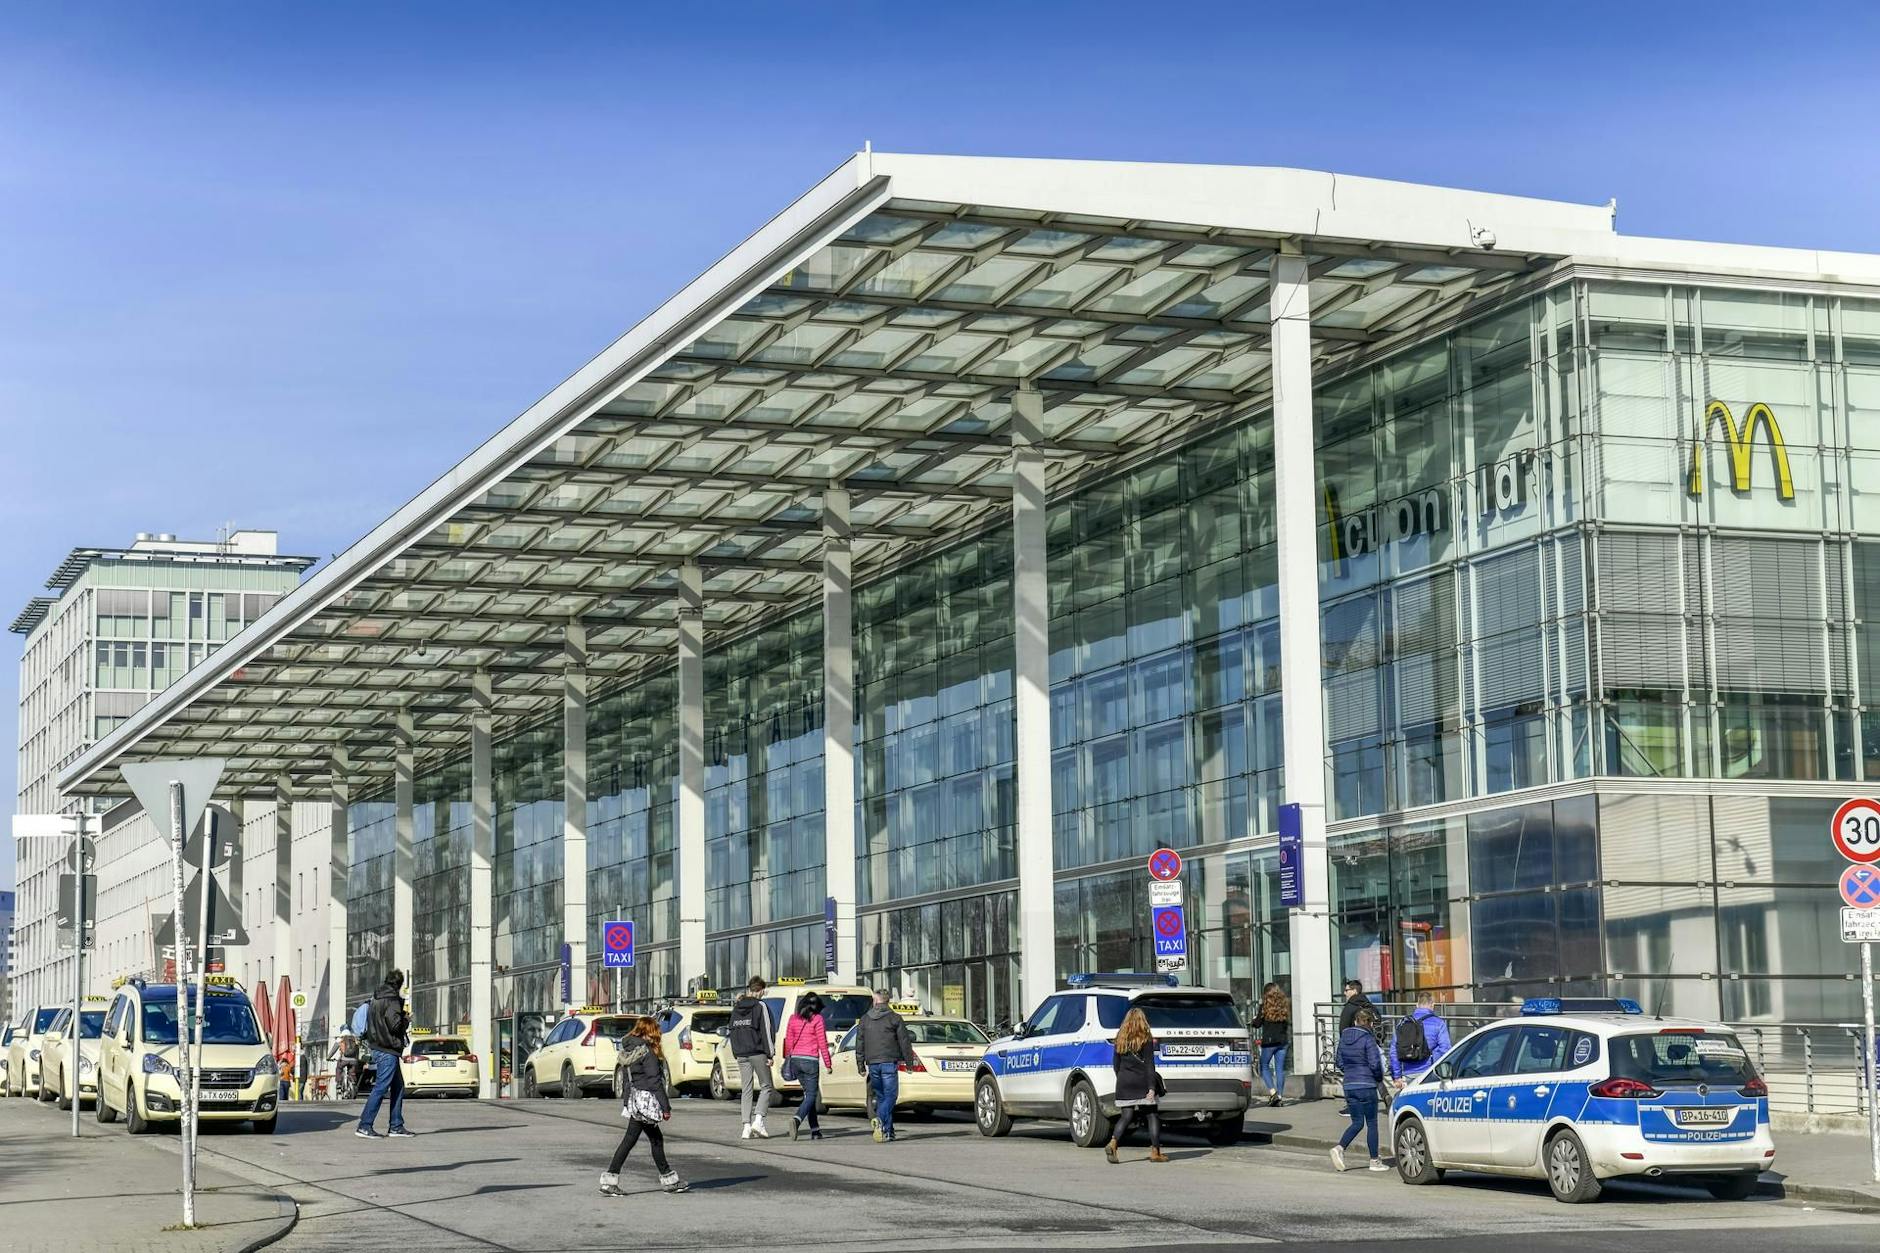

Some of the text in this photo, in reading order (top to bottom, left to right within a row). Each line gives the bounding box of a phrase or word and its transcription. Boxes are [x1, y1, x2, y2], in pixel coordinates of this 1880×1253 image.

[1846, 816, 1880, 845] 30
[1158, 940, 1183, 951] TAXI
[607, 953, 631, 963] TAXI
[1007, 1054, 1032, 1069] POLIZEI
[1218, 1055, 1247, 1064] POLIZEI
[219, 1091, 237, 1099] 6965
[1435, 1096, 1472, 1113] POLIZEI
[1681, 1110, 1727, 1121] BP 16-410
[1687, 1131, 1721, 1141] POLIZEI
